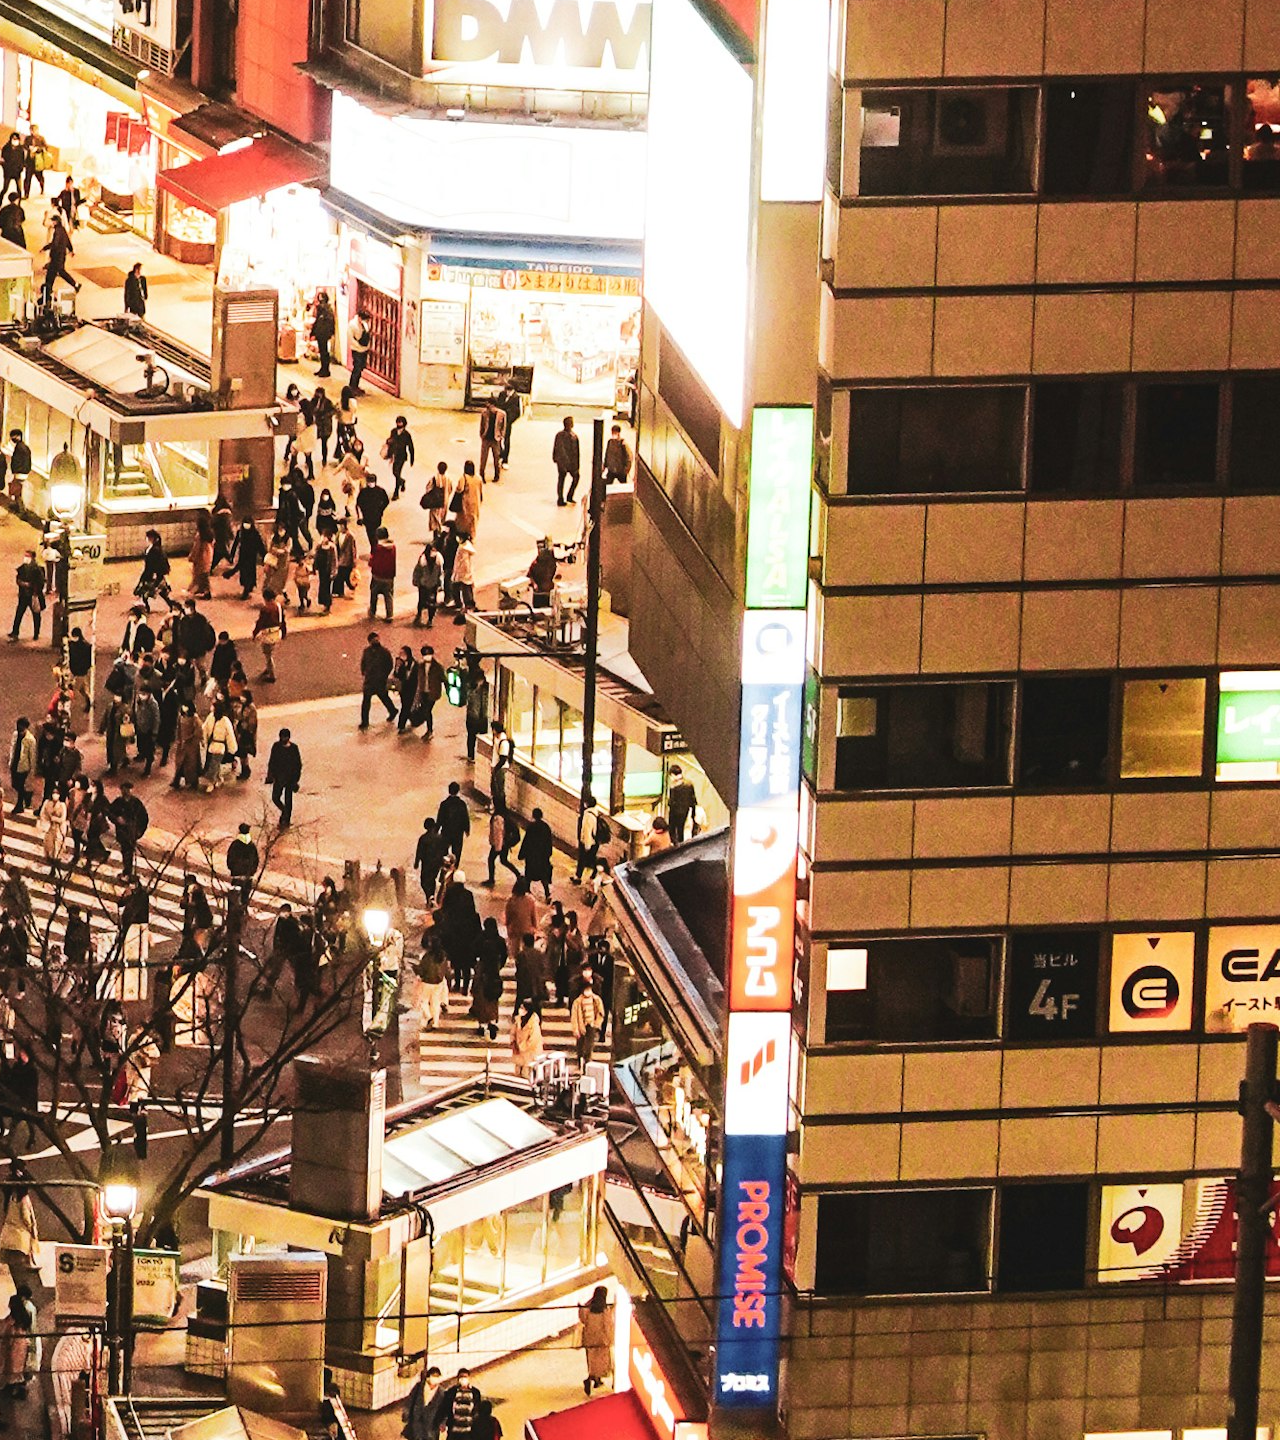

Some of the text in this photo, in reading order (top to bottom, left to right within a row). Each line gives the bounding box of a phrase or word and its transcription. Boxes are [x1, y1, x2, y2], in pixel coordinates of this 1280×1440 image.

[525, 262, 594, 275] TAISEIDO
[745, 905, 782, 997] アコム
[1032, 952, 1078, 969] 当ビル
[1027, 979, 1080, 1021] 4F
[733, 1180, 770, 1329] PROMISE
[719, 1372, 771, 1393] プロミス
